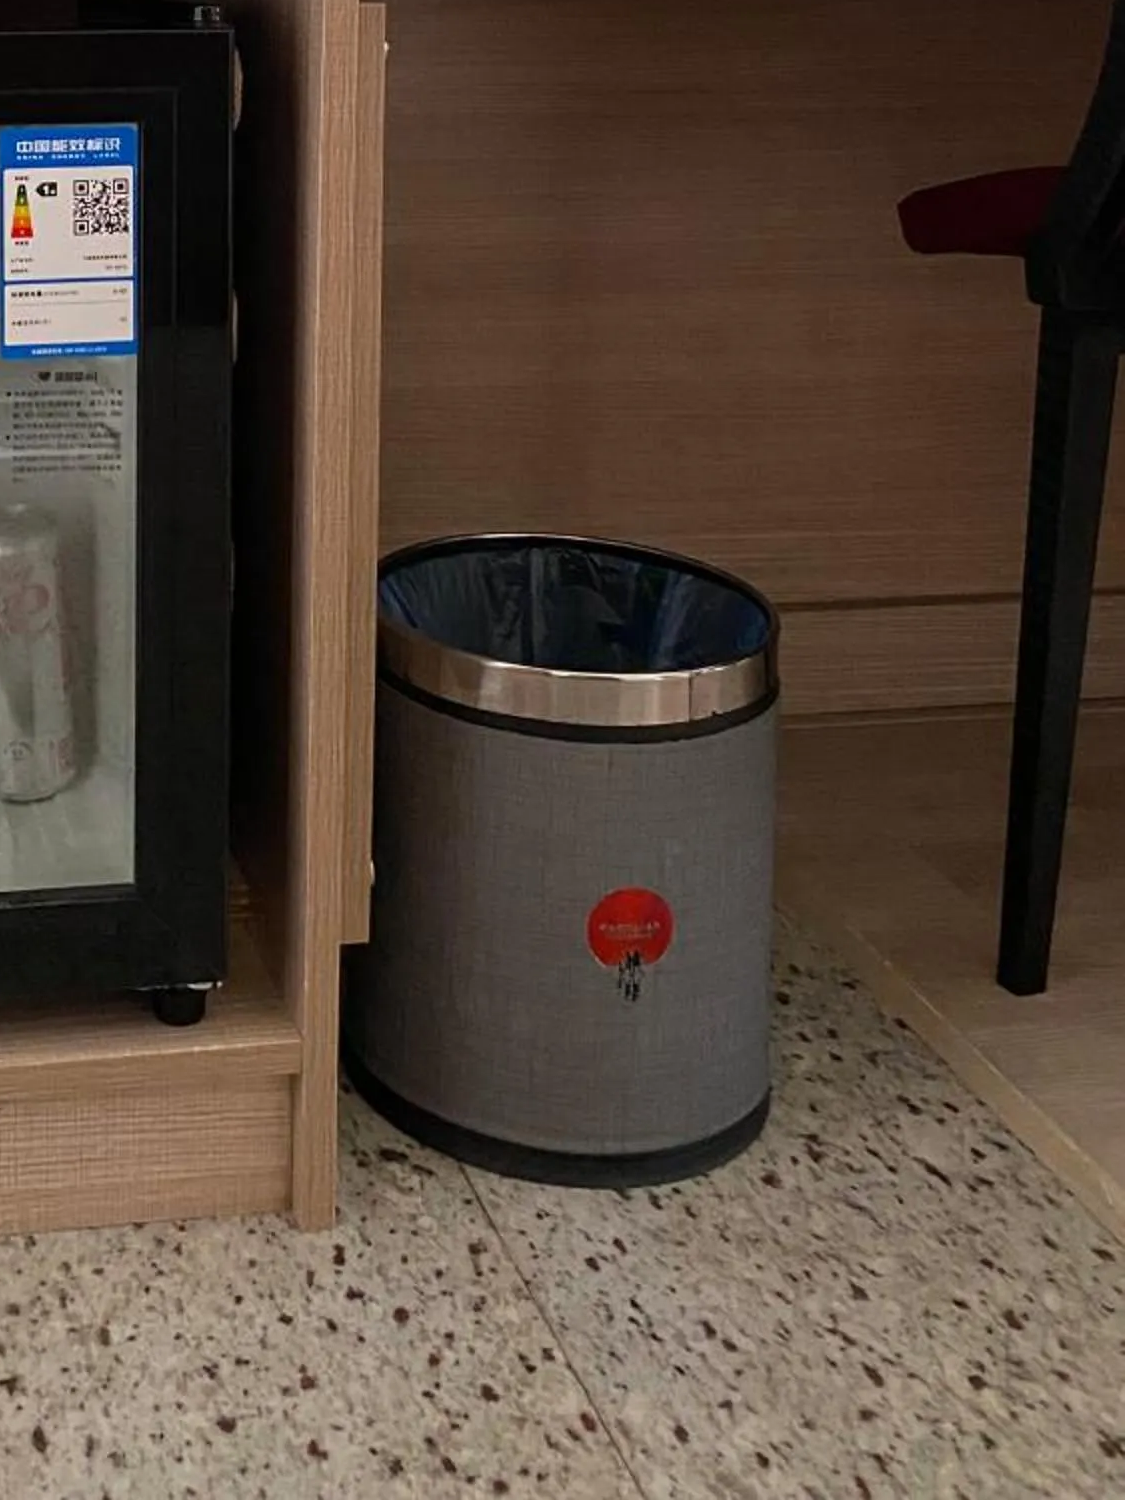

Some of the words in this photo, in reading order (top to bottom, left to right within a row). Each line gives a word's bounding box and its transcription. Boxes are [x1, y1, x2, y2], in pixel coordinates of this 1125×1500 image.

[16, 137, 120, 153] 中国能效标识
